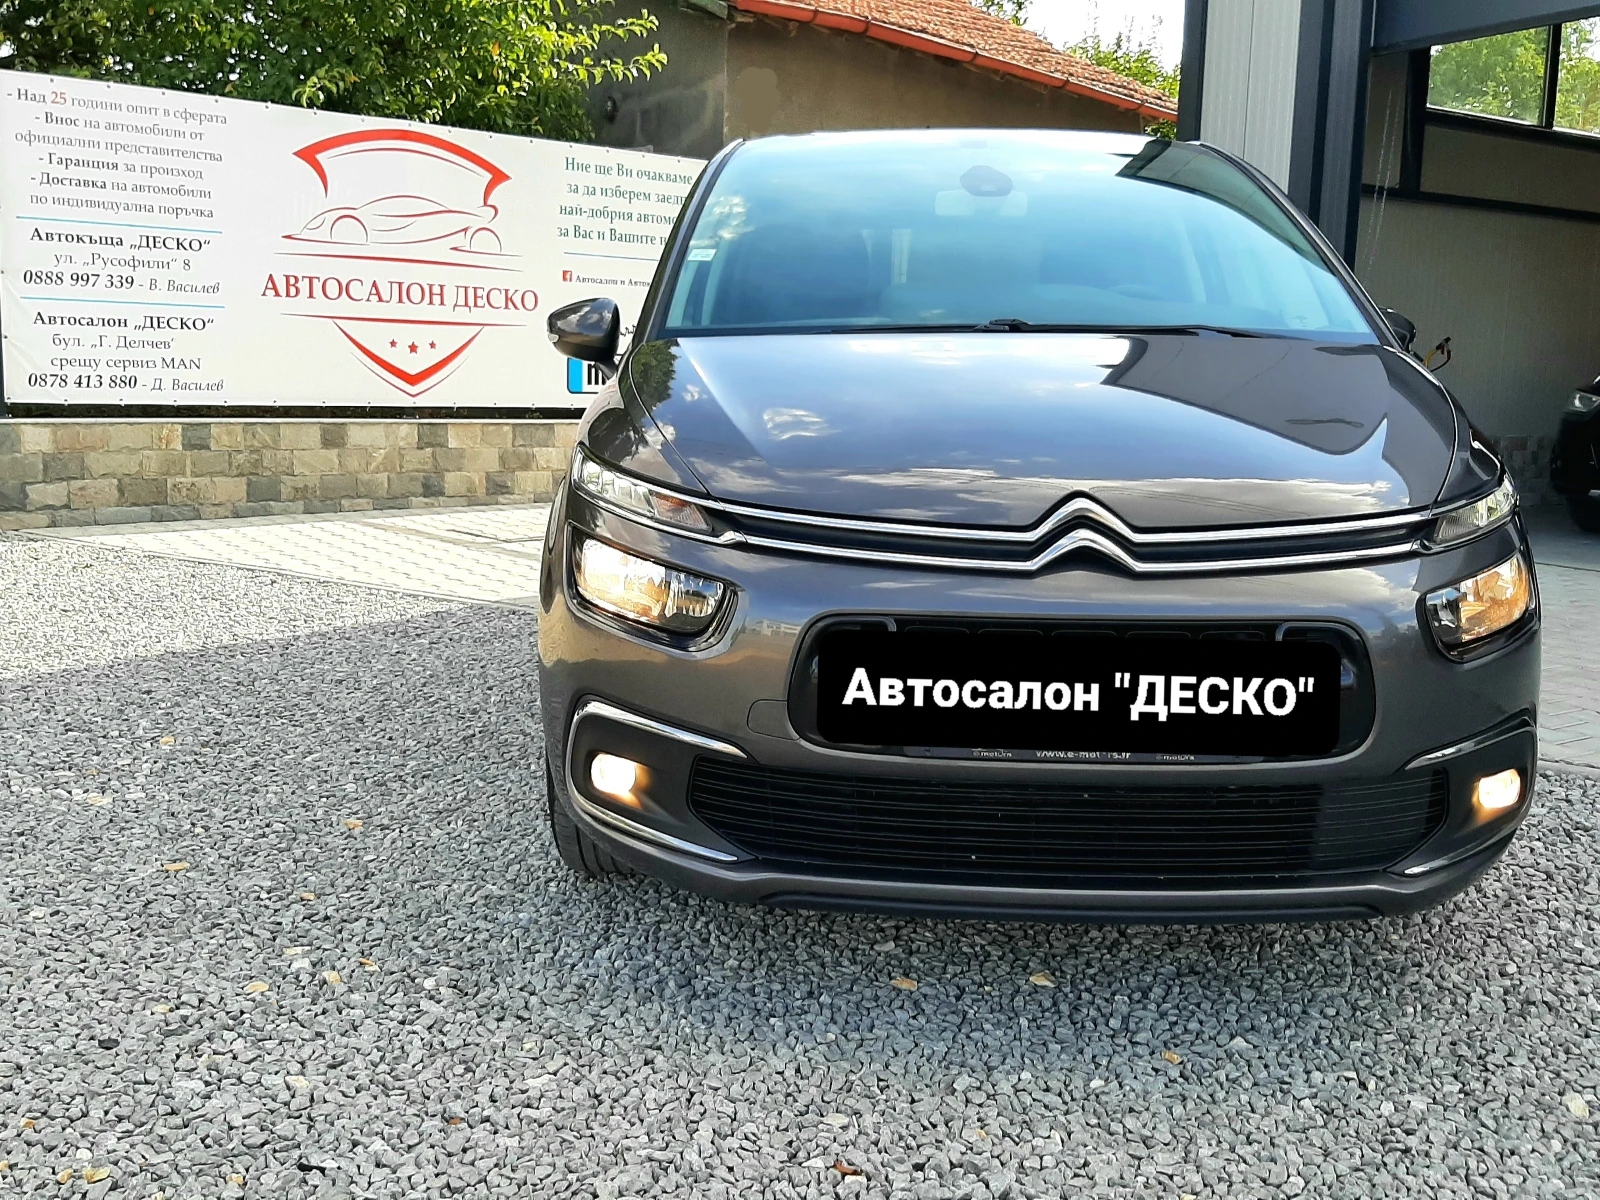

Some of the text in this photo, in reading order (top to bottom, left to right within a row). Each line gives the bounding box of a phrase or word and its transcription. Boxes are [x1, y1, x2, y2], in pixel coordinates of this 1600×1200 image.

[17, 88, 47, 104] Над
[51, 91, 67, 105] 25
[71, 96, 123, 112] години
[127, 103, 160, 118] опит
[163, 106, 170, 117] в
[173, 107, 227, 125] сферата
[45, 111, 79, 127] Внос
[84, 118, 100, 129] на
[105, 121, 186, 139] автомобили
[190, 130, 205, 141] от
[15, 130, 223, 162] официални представителства
[48, 152, 119, 172] Гаранция
[123, 161, 136, 173] за
[140, 164, 204, 180] произход
[565, 157, 693, 185] Ние ще Ви очакваме
[40, 172, 107, 190] Доставка
[111, 180, 127, 191] на
[131, 182, 212, 199] автомобили
[566, 183, 579, 194] за
[582, 185, 596, 197] да
[600, 185, 651, 204] изберем
[30, 194, 214, 219] по индивидуална поръчка
[559, 204, 633, 224] най-добрия
[30, 227, 124, 247] Автокъща
[557, 226, 569, 238] за
[573, 225, 594, 240] Вас
[597, 230, 605, 240] и
[609, 228, 657, 245] Вашите
[54, 253, 77, 267] ул.
[183, 258, 191, 272] 8
[23, 270, 64, 286] 0888
[70, 272, 100, 288] 997
[104, 275, 135, 290] 339
[149, 278, 162, 292] В.
[167, 279, 220, 294] Василев
[575, 275, 618, 285] Автосалон
[261, 273, 539, 313] АВТОСАЛОН ДЕСКО
[33, 311, 128, 328] Автосалон
[52, 334, 85, 350] бул.
[50, 356, 202, 373] срещу сервиз MAN
[28, 373, 68, 388] 0878
[74, 374, 103, 389] 413
[108, 375, 137, 389] 880
[151, 378, 167, 391] Д.
[172, 378, 224, 392] Василев
